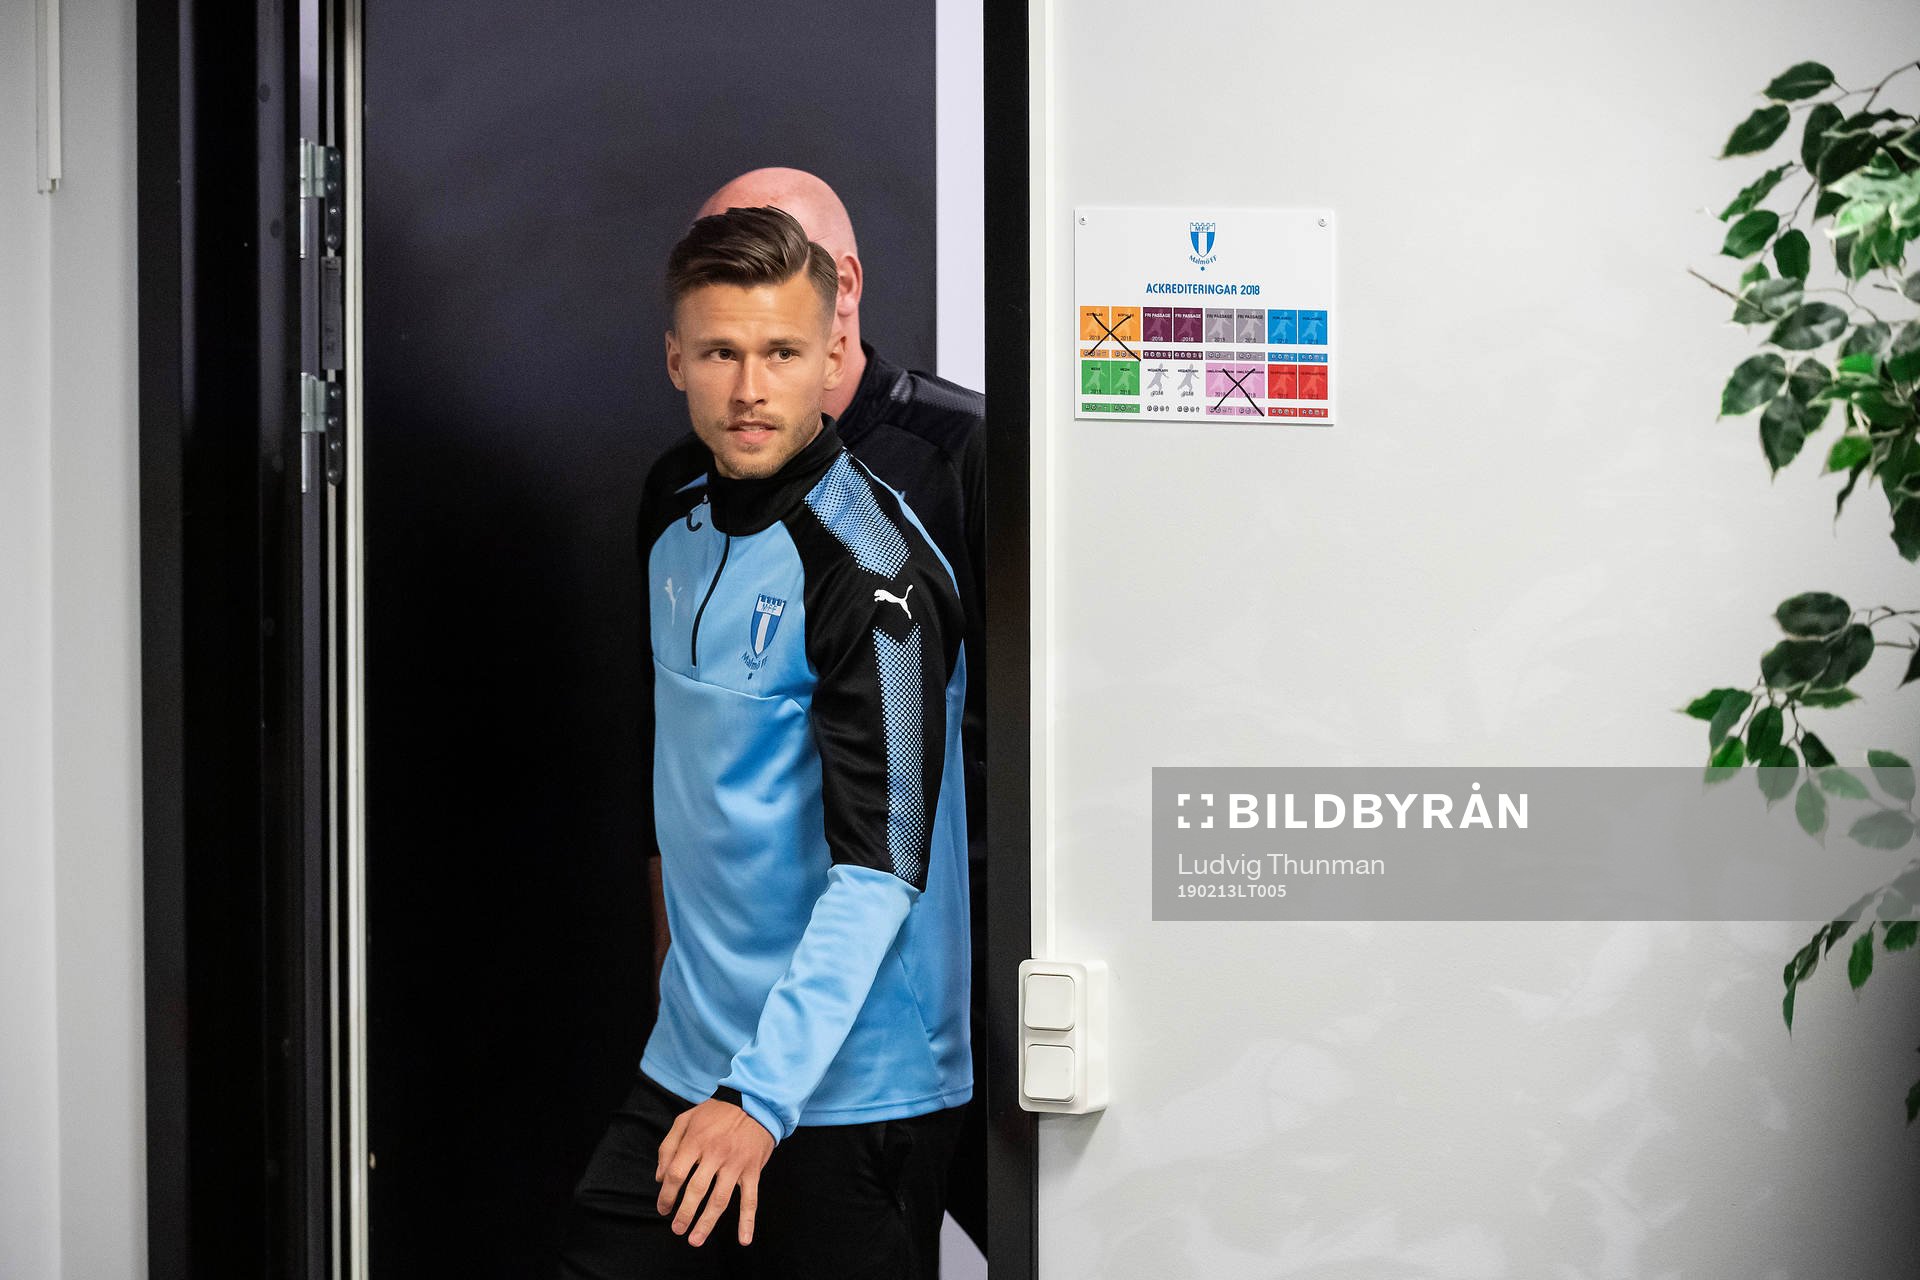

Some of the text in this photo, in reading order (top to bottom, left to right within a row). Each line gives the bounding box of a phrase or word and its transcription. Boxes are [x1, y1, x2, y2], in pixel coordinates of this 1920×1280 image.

[1189, 255, 1210, 265] Malmö
[1146, 283, 1260, 295] ACKREDITERINGAR 2018
